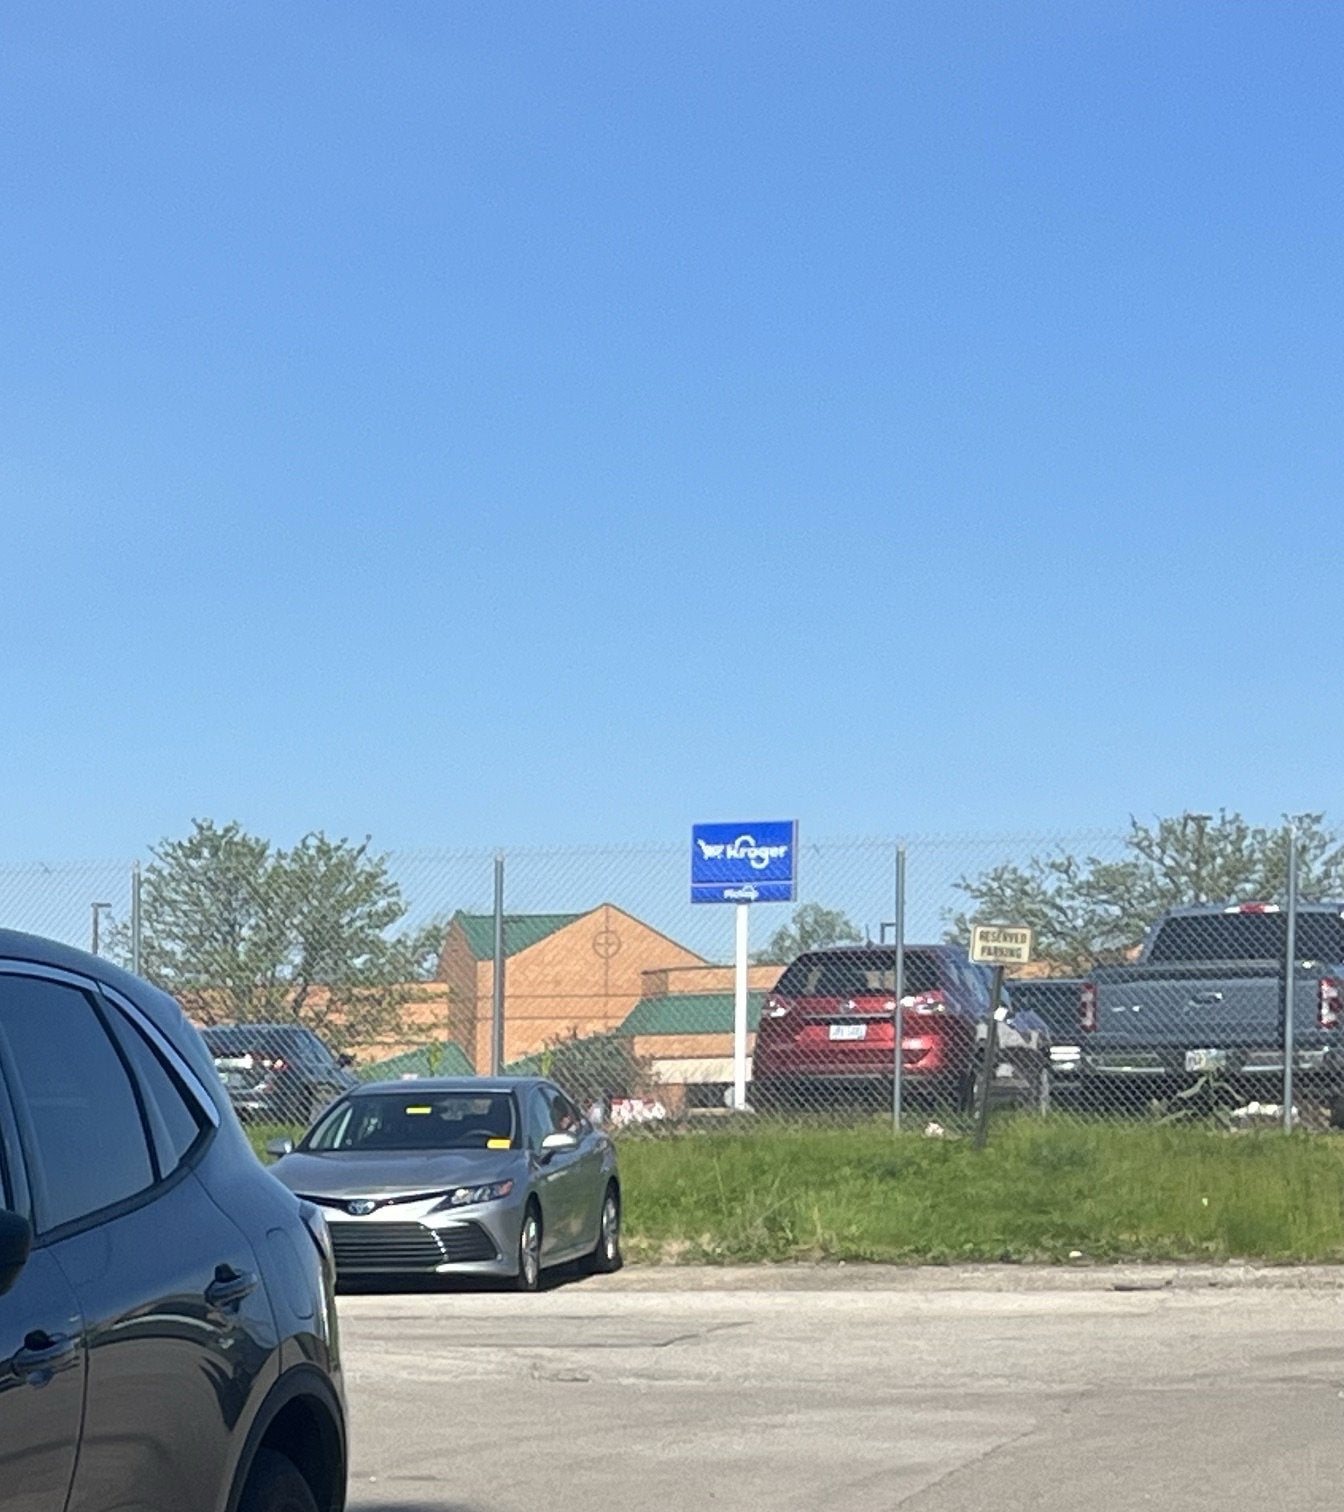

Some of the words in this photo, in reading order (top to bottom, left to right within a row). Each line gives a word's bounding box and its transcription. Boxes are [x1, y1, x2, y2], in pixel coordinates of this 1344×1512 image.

[726, 835, 787, 869] Kroger
[979, 930, 1027, 943] RESERVED
[980, 945, 1022, 959] PARKING
